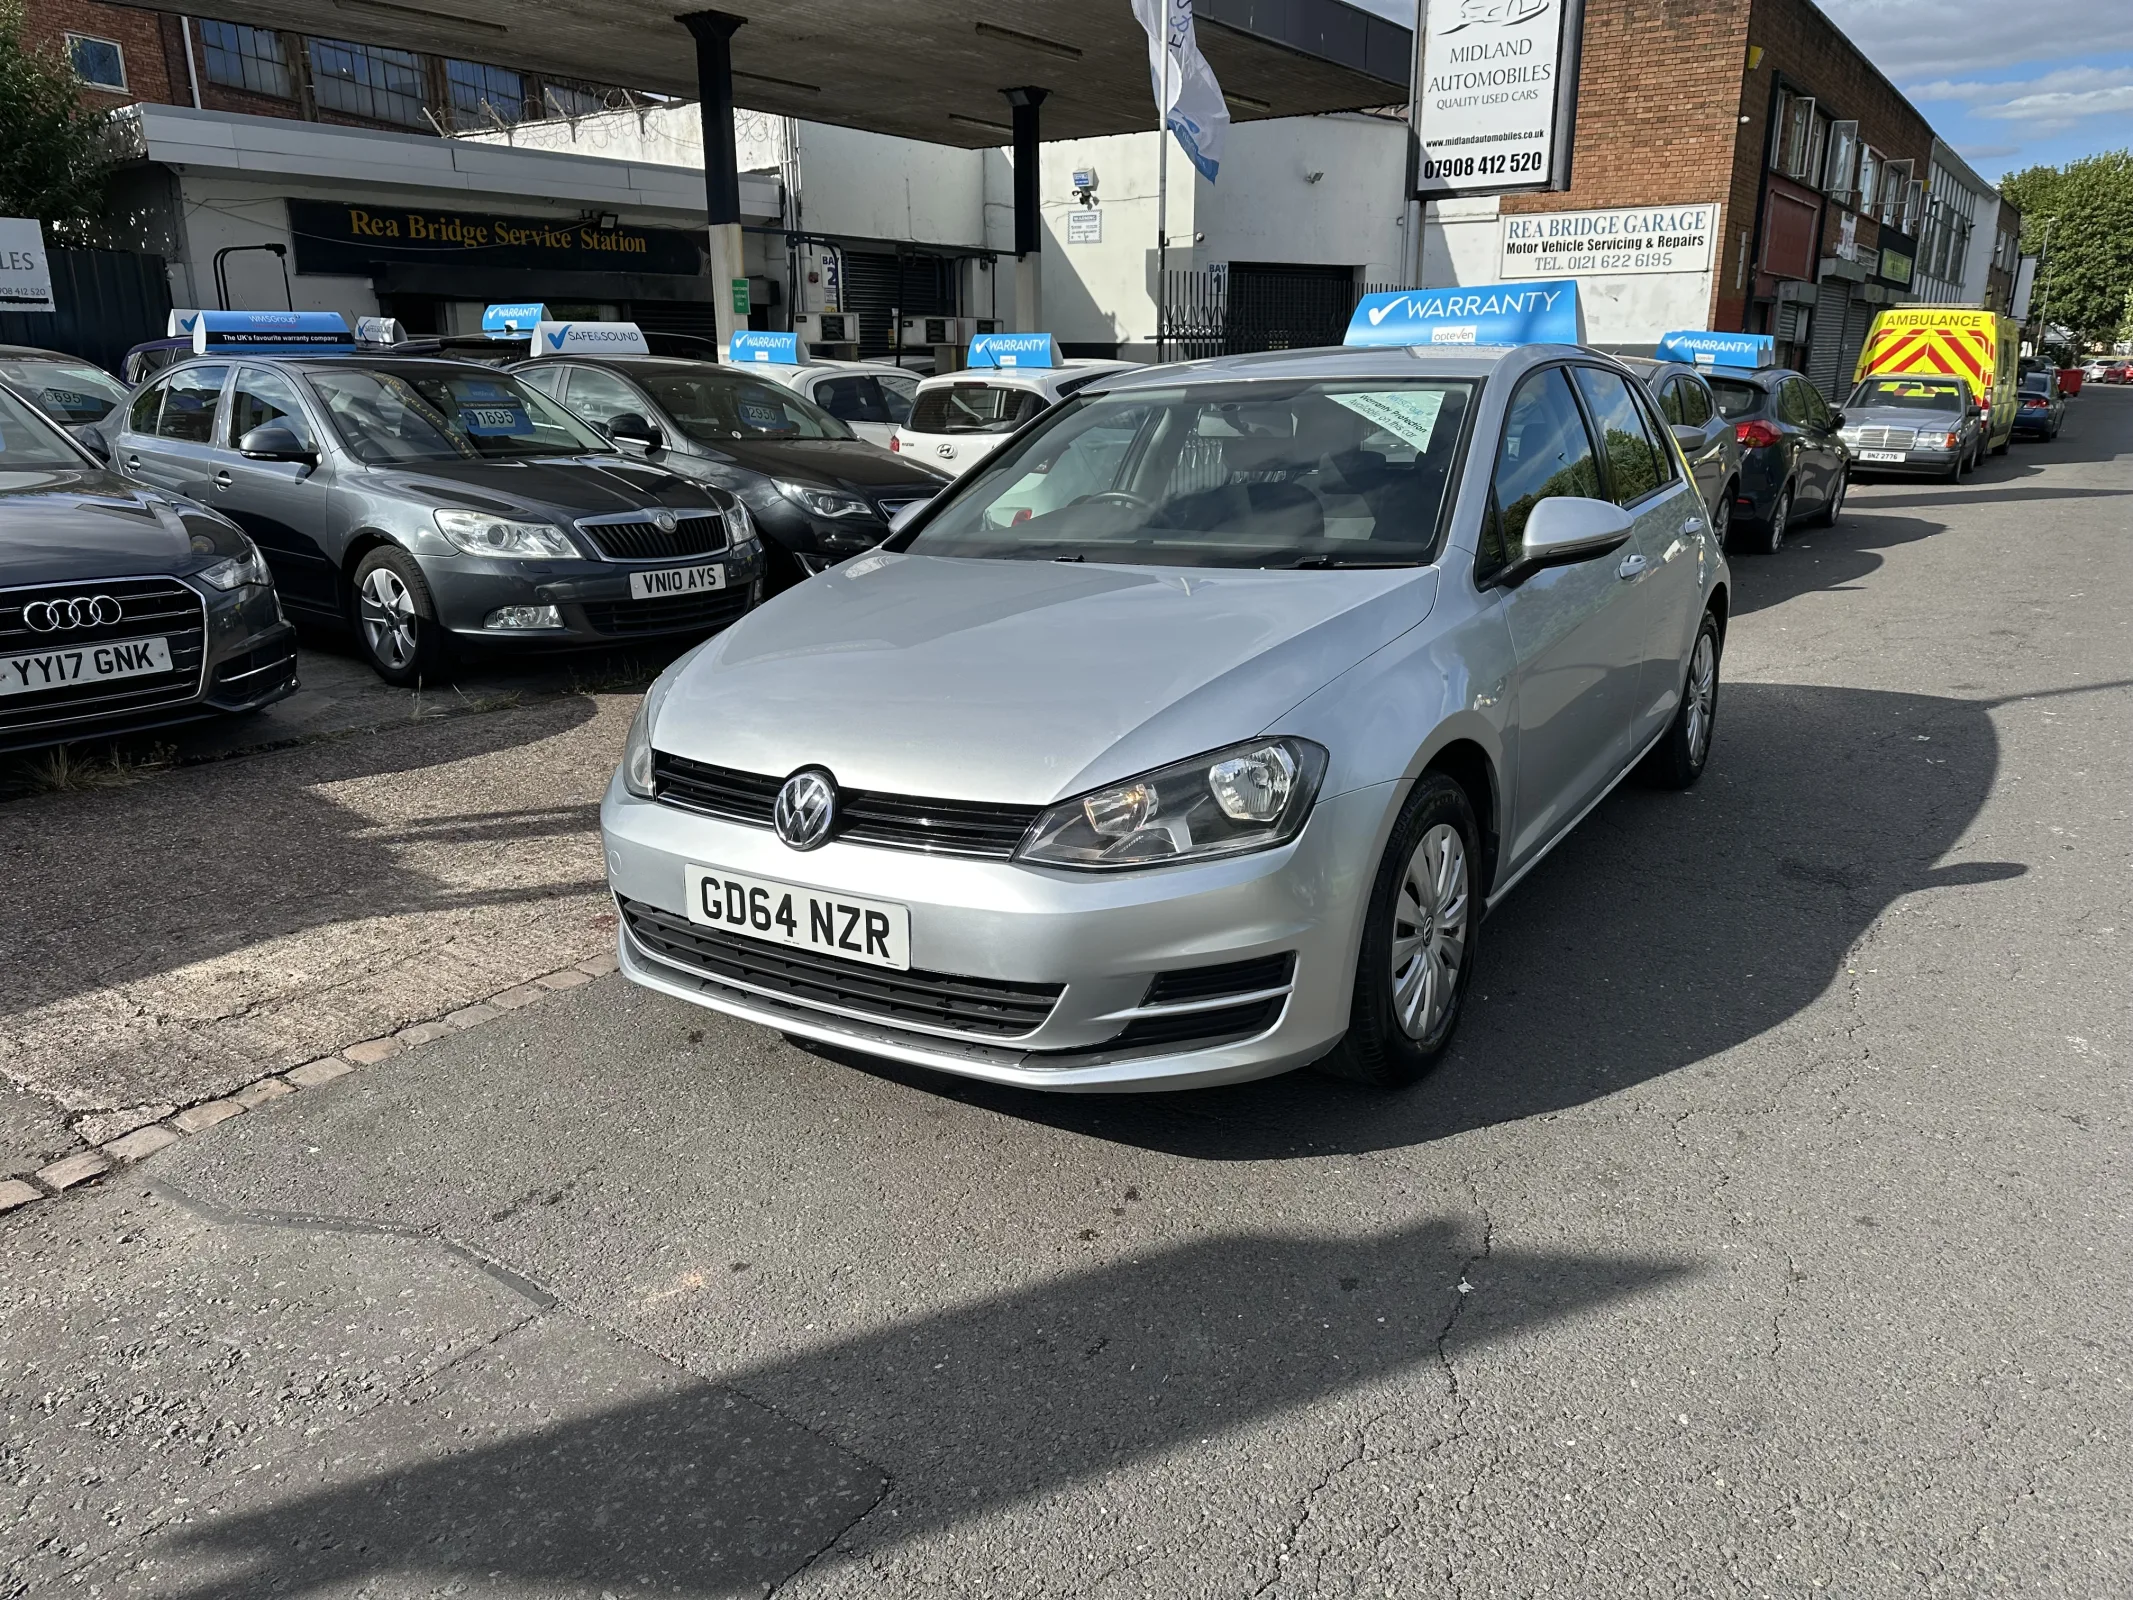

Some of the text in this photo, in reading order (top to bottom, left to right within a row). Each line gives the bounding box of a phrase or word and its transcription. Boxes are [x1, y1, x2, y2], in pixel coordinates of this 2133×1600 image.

[1449, 38, 1533, 64] MIDLAND
[1428, 63, 1552, 93] AUTOMOBILES
[1436, 89, 1539, 110] QUALITY USED CARS
[1425, 129, 1545, 148] www.midlandautomobiles.co.uk
[1424, 151, 1542, 180] 07908 412 520
[348, 209, 648, 254] Rea Bridge Service Station
[1508, 210, 1707, 240] REA BRIDGE GARAGE
[1506, 234, 1705, 255] Motor Vehicle Servicing & Repairs
[1209, 264, 1227, 273] BAY
[1535, 252, 1673, 272] TEL. 0121 622 6195
[30, 288, 46, 296] 520
[497, 306, 540, 318] WARRANTY
[1406, 290, 1562, 320] WARRANTY
[248, 315, 297, 324] WMSGroup
[1885, 314, 1982, 328] AMBULANCE
[222, 334, 338, 343] The UK's favourite warranty company
[567, 330, 639, 343] SAFE&SOUND
[746, 336, 793, 349] WARRANTY
[989, 337, 1047, 352] WARRANTY
[1433, 328, 1475, 342] opteven
[1683, 338, 1753, 354] WARRANTY
[1359, 394, 1428, 433] Warranty Protection
[642, 567, 717, 594] VN10 AYS
[11, 643, 155, 686] YY17 GNK
[700, 876, 891, 959] GD64 NZR
